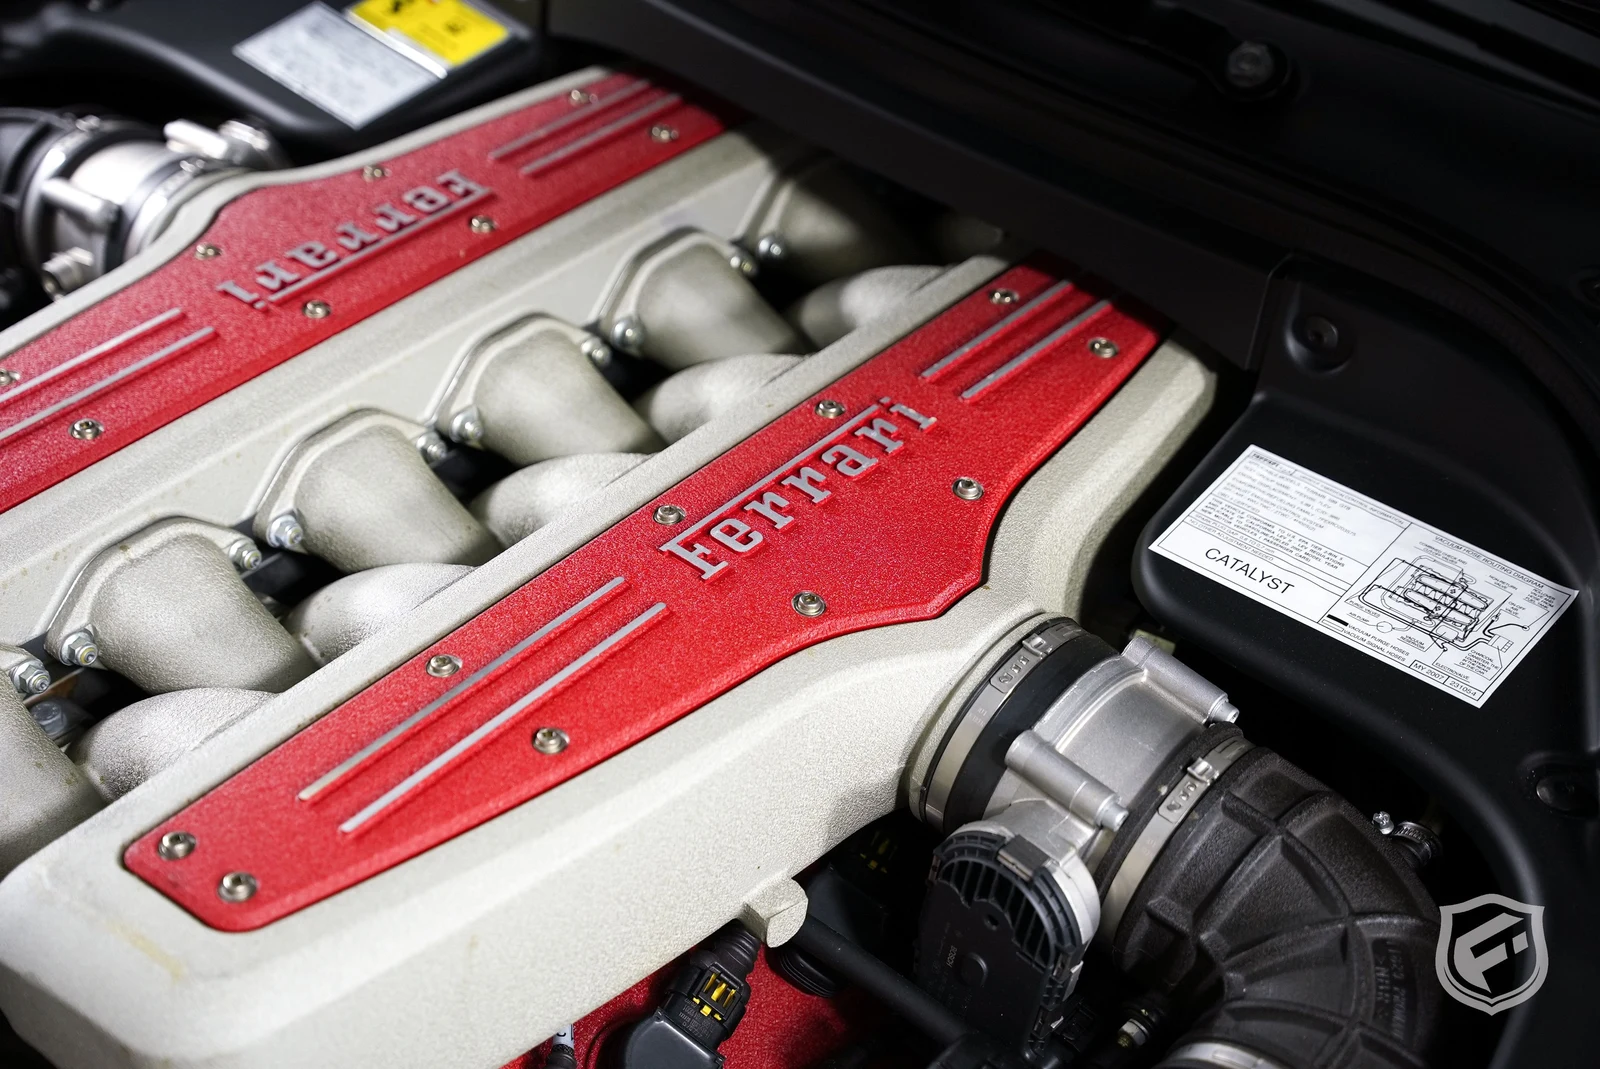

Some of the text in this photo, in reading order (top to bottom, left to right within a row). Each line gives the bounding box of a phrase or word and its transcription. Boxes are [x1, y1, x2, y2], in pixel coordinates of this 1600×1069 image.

[216, 168, 493, 311] Ferrari
[658, 396, 938, 581] Ferrari
[1233, 498, 1261, 513] CERTIFIED
[1249, 493, 1276, 506] EMISSION
[1275, 505, 1300, 518] CONTROL
[1301, 517, 1324, 529] SYSTEM
[1295, 506, 1314, 516] FAMILY
[1194, 514, 1211, 523] SPARK
[1210, 521, 1226, 530] PLUG
[1367, 506, 1404, 524] INFORMATION
[1212, 514, 1232, 524] MOTOR
[1232, 523, 1258, 536] VEHICLES
[1262, 537, 1294, 553] PASSENGER
[1223, 503, 1245, 515] VEHICLE
[1245, 513, 1275, 529] CONFORMS
[1297, 537, 1309, 545] EPA
[1310, 543, 1323, 551] TIER
[1197, 523, 1216, 533] OTHER
[1215, 531, 1252, 550] ADJUSTMENT
[1250, 548, 1274, 561] NEEDED
[1204, 504, 1234, 520] APPLICABLE
[1303, 551, 1322, 562] MODEL
[1323, 561, 1338, 569] YEAR
[1219, 506, 1235, 515] STATE
[1244, 518, 1276, 534] CALIFORNIA
[1308, 548, 1345, 567] REGULATIONS
[1433, 535, 1544, 588] VACUUM HOSE ROUTING DIAGRAM
[1200, 546, 1295, 596] CATALYST
[1493, 581, 1508, 589] VALVE
[1348, 600, 1381, 618] PURGE VALVES
[1504, 607, 1519, 615] VALVE
[1355, 615, 1370, 623] PUMP
[1341, 629, 1406, 662] VACUUM SIGNAL HOSES
[1346, 624, 1410, 656] VACUUM PURGE HOSES
[1398, 635, 1425, 650] RESERVOIR
[1404, 634, 1425, 646] VACUUM
[1463, 655, 1487, 668] LOCATION
[1469, 649, 1494, 662] CHARCOAL
[1412, 663, 1444, 680] MY 2007
[1434, 661, 1470, 680] ELECTROVALVE
[1475, 665, 1489, 673] REAR
[1448, 680, 1477, 696] 231054
[946, 945, 958, 968] BOSCH
